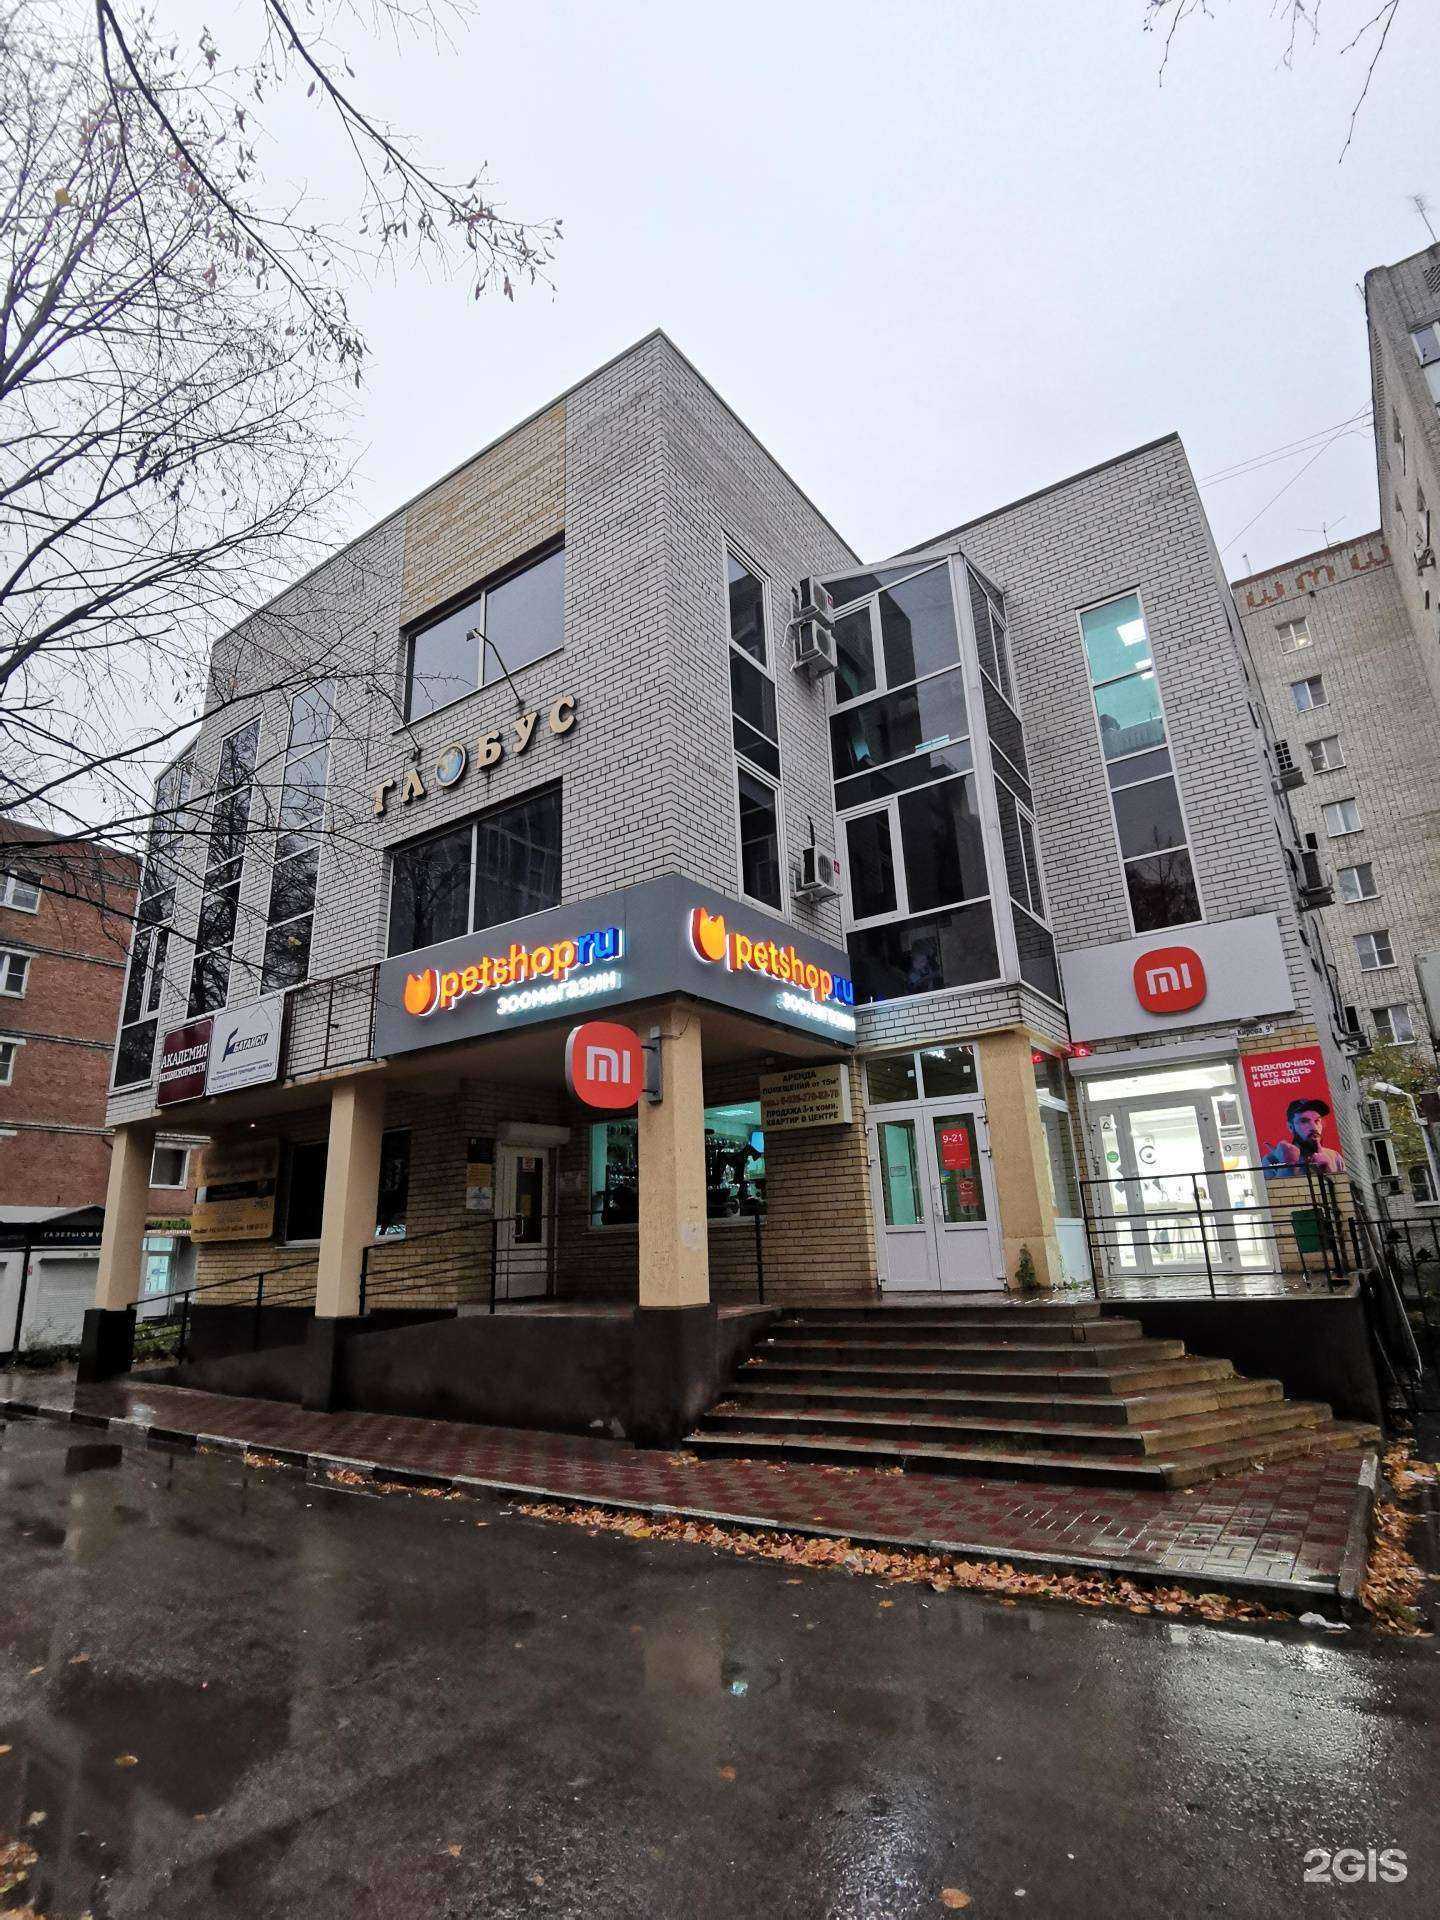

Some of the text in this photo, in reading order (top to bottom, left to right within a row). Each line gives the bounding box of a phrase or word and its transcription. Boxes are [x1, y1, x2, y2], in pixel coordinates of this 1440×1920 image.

[373, 694, 577, 815] ГЛОБУС
[161, 1042, 208, 1069] АКАДЕМИЯ
[1250, 1059, 1316, 1073] ПОДКЛЮЧИСЬ
[782, 1070, 817, 1082] АРЕНДА
[1252, 1067, 1311, 1081] К МТС ЗДЕСЬ
[1254, 1076, 1301, 1088] И СЕЙЧАС!
[808, 1111, 839, 1122] ЦЕНТРЕ
